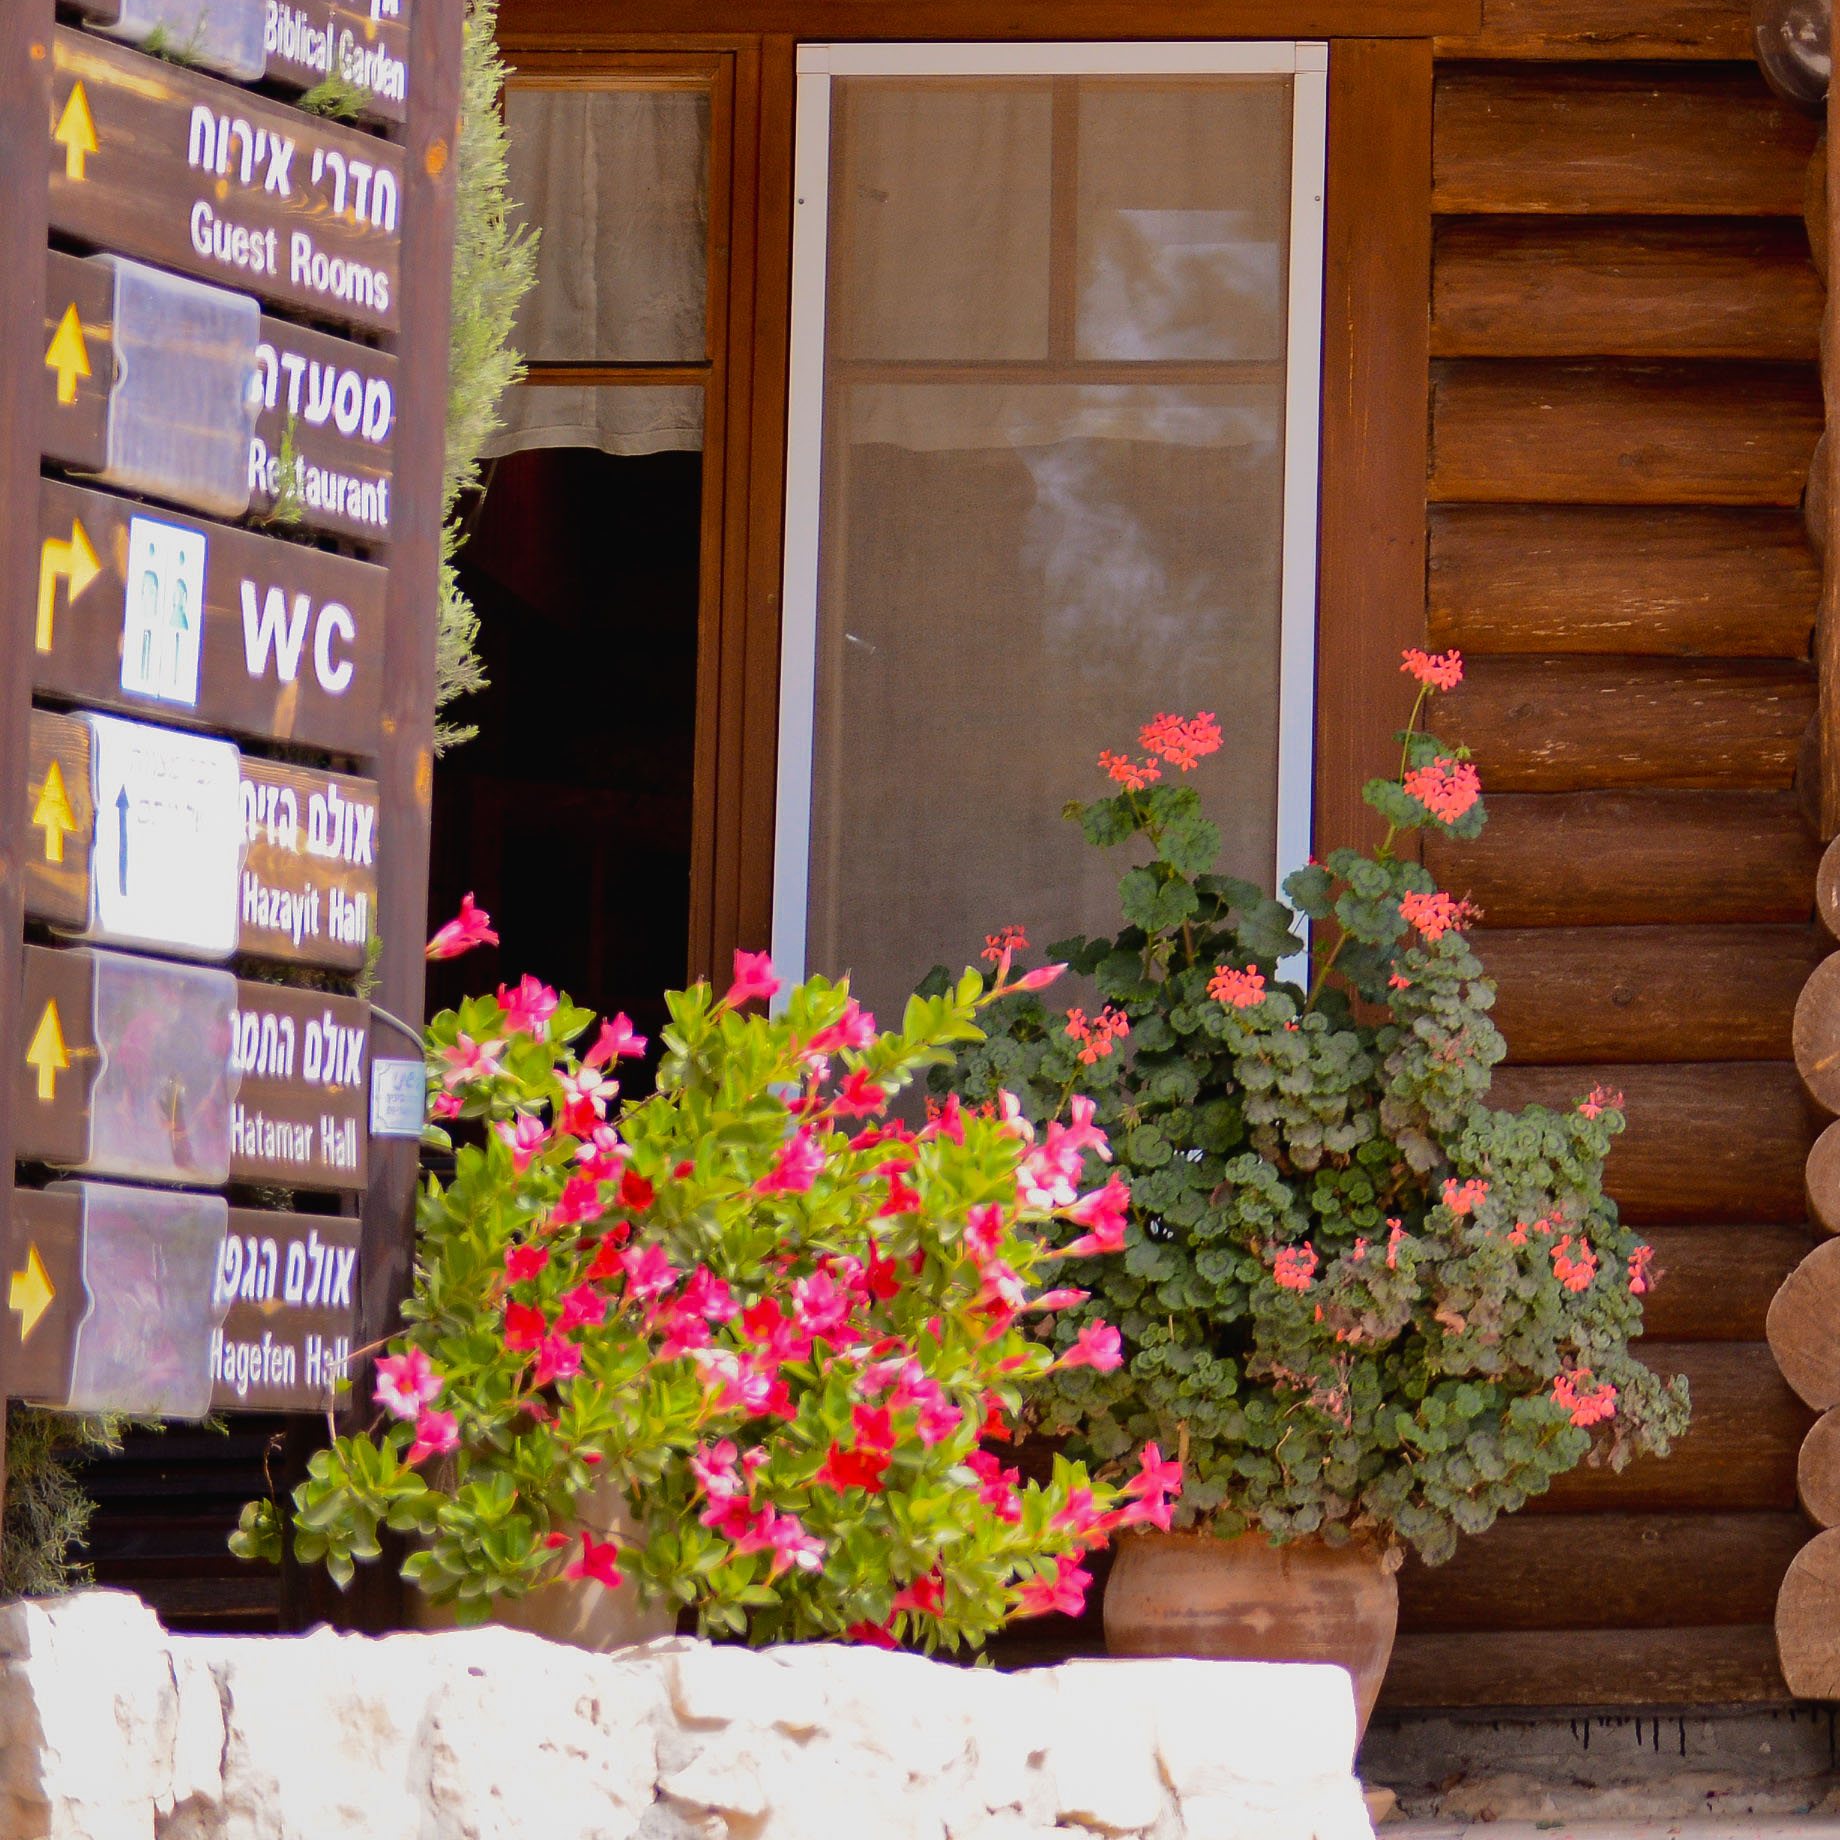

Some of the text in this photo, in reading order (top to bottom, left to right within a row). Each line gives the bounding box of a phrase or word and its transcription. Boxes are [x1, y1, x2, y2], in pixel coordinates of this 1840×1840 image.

[263, 0, 407, 103] Biblical Garden
[188, 105, 397, 231] חדרי אירוח
[190, 201, 390, 312] Guest Rooms
[251, 344, 392, 442] מסעדה
[240, 579, 356, 692] WC
[307, 783, 375, 866] אולם
[242, 871, 368, 948] Hazayit Hall
[302, 1010, 365, 1086] אולם
[231, 1103, 357, 1169] Hatamar Hall
[284, 1228, 356, 1306] אולם
[209, 1327, 350, 1396] Hagefen Hall
